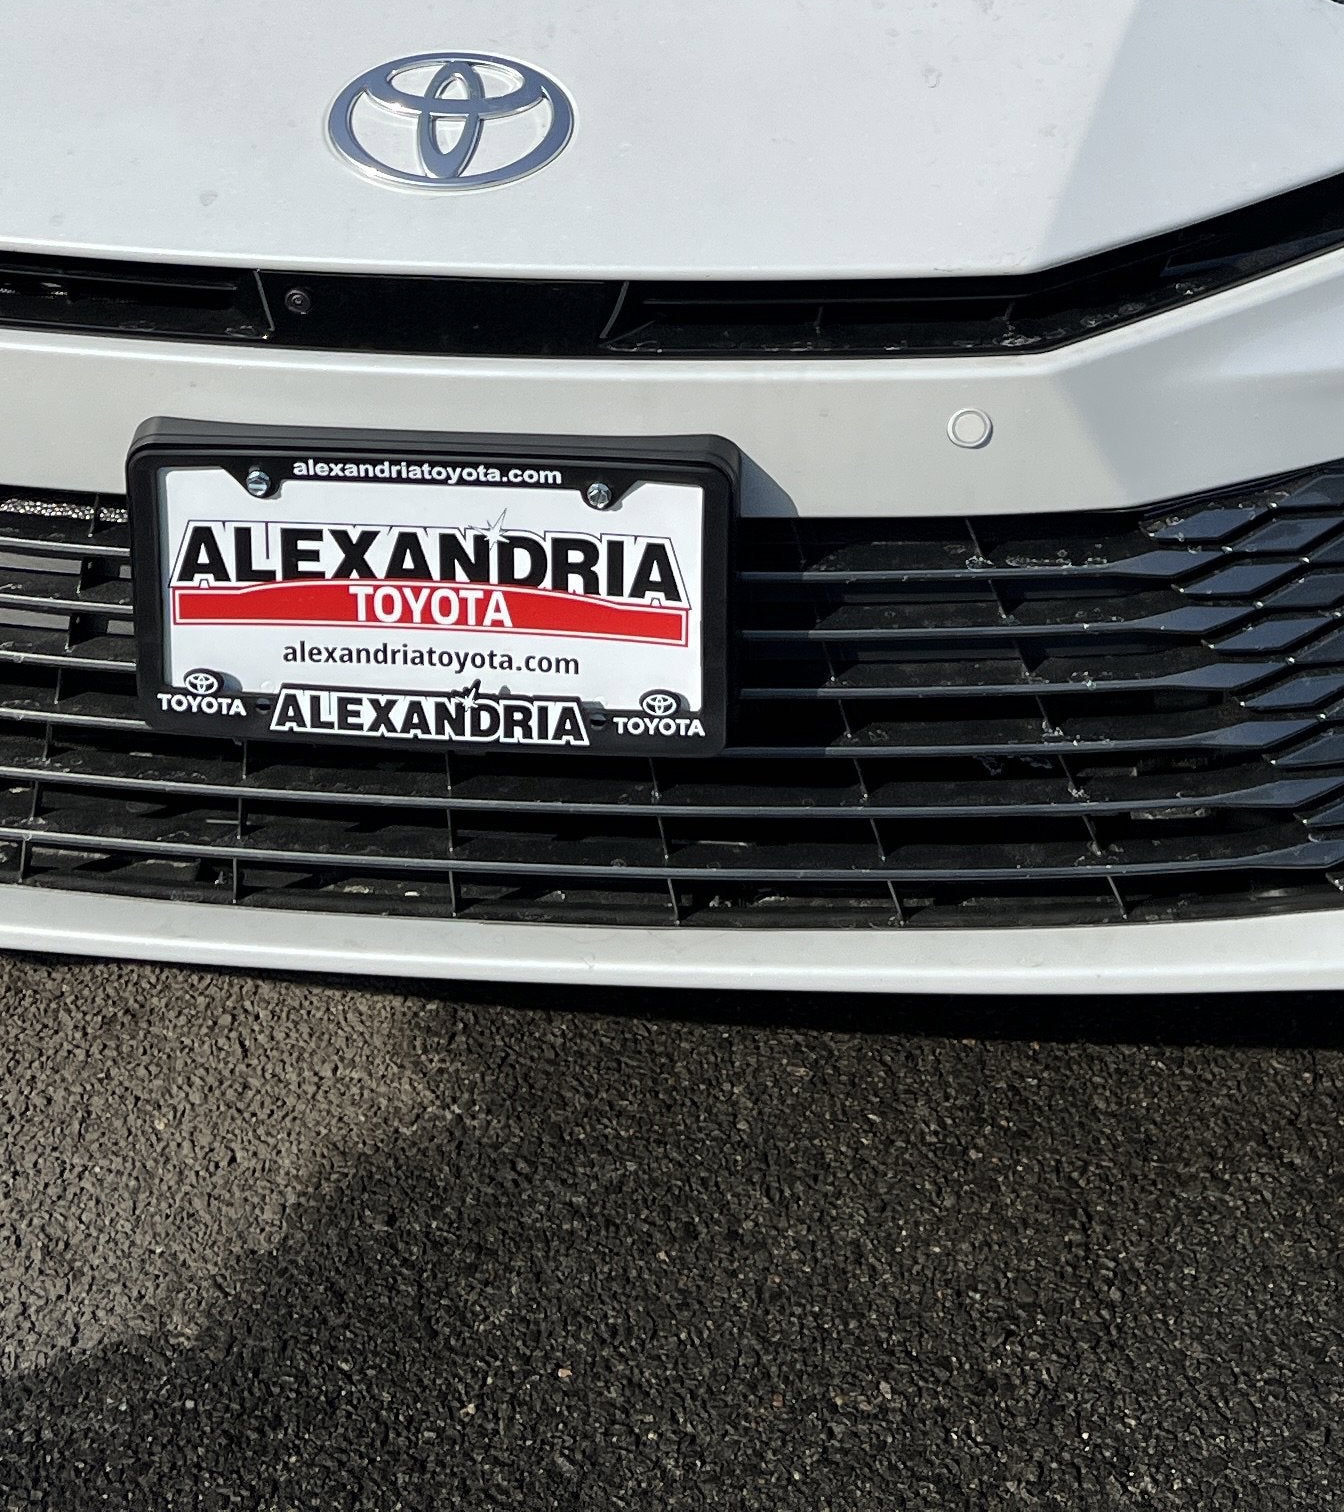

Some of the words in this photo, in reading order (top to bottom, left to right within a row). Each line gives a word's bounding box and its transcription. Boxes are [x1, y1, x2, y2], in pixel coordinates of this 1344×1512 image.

[293, 459, 562, 484] alexandriatoyota.com
[175, 524, 684, 604] ALEXANDRIA
[348, 585, 514, 627] TOYOTA
[282, 640, 580, 675] alexandriatoyota.com
[156, 693, 247, 716] TOYOTA
[272, 690, 588, 744] ALEXANDRIA
[613, 717, 706, 737] TOYOTA
